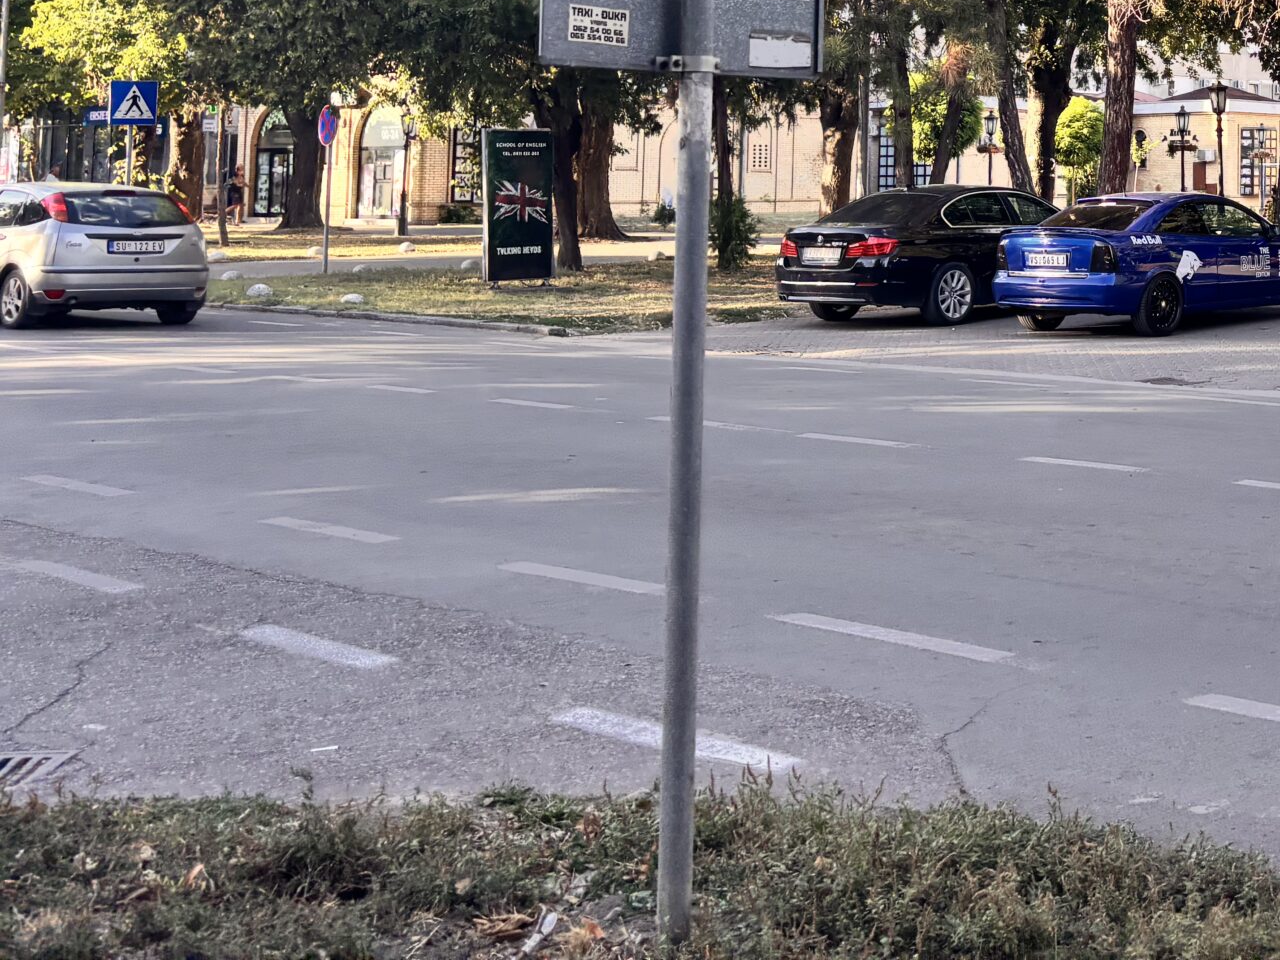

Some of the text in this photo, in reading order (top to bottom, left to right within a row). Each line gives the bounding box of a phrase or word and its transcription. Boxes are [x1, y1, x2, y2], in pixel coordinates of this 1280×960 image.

[572, 6, 593, 18] TAXI
[601, 28, 612, 36] 00
[603, 35, 614, 43] 00
[1146, 234, 1163, 245] Bull
[134, 242, 149, 251] 122
[1259, 246, 1270, 254] THE
[1240, 254, 1271, 271] BLUE
